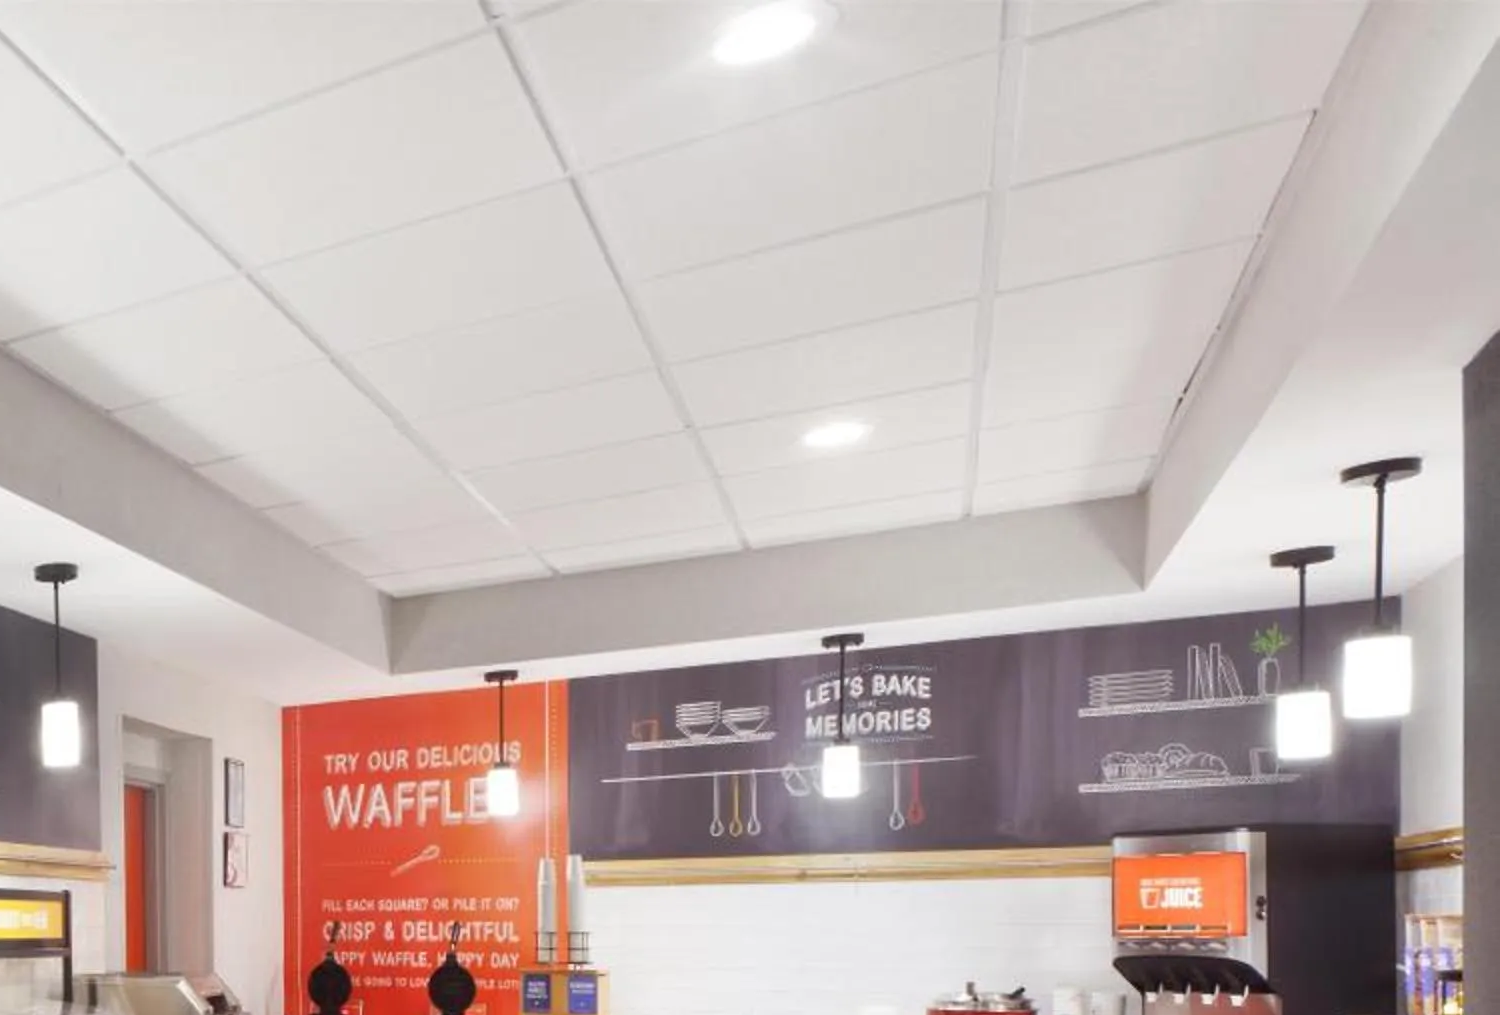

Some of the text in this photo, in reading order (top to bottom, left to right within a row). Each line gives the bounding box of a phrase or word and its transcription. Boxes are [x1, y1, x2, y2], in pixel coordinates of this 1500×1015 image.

[804, 674, 932, 710] LET'S BAKE
[804, 707, 932, 738] MEMORIES
[324, 741, 521, 775] TRY OUR DELICIOUS
[323, 776, 516, 830] WAFFLE
[1160, 887, 1204, 909] JUICE
[490, 951, 520, 969] DAY
